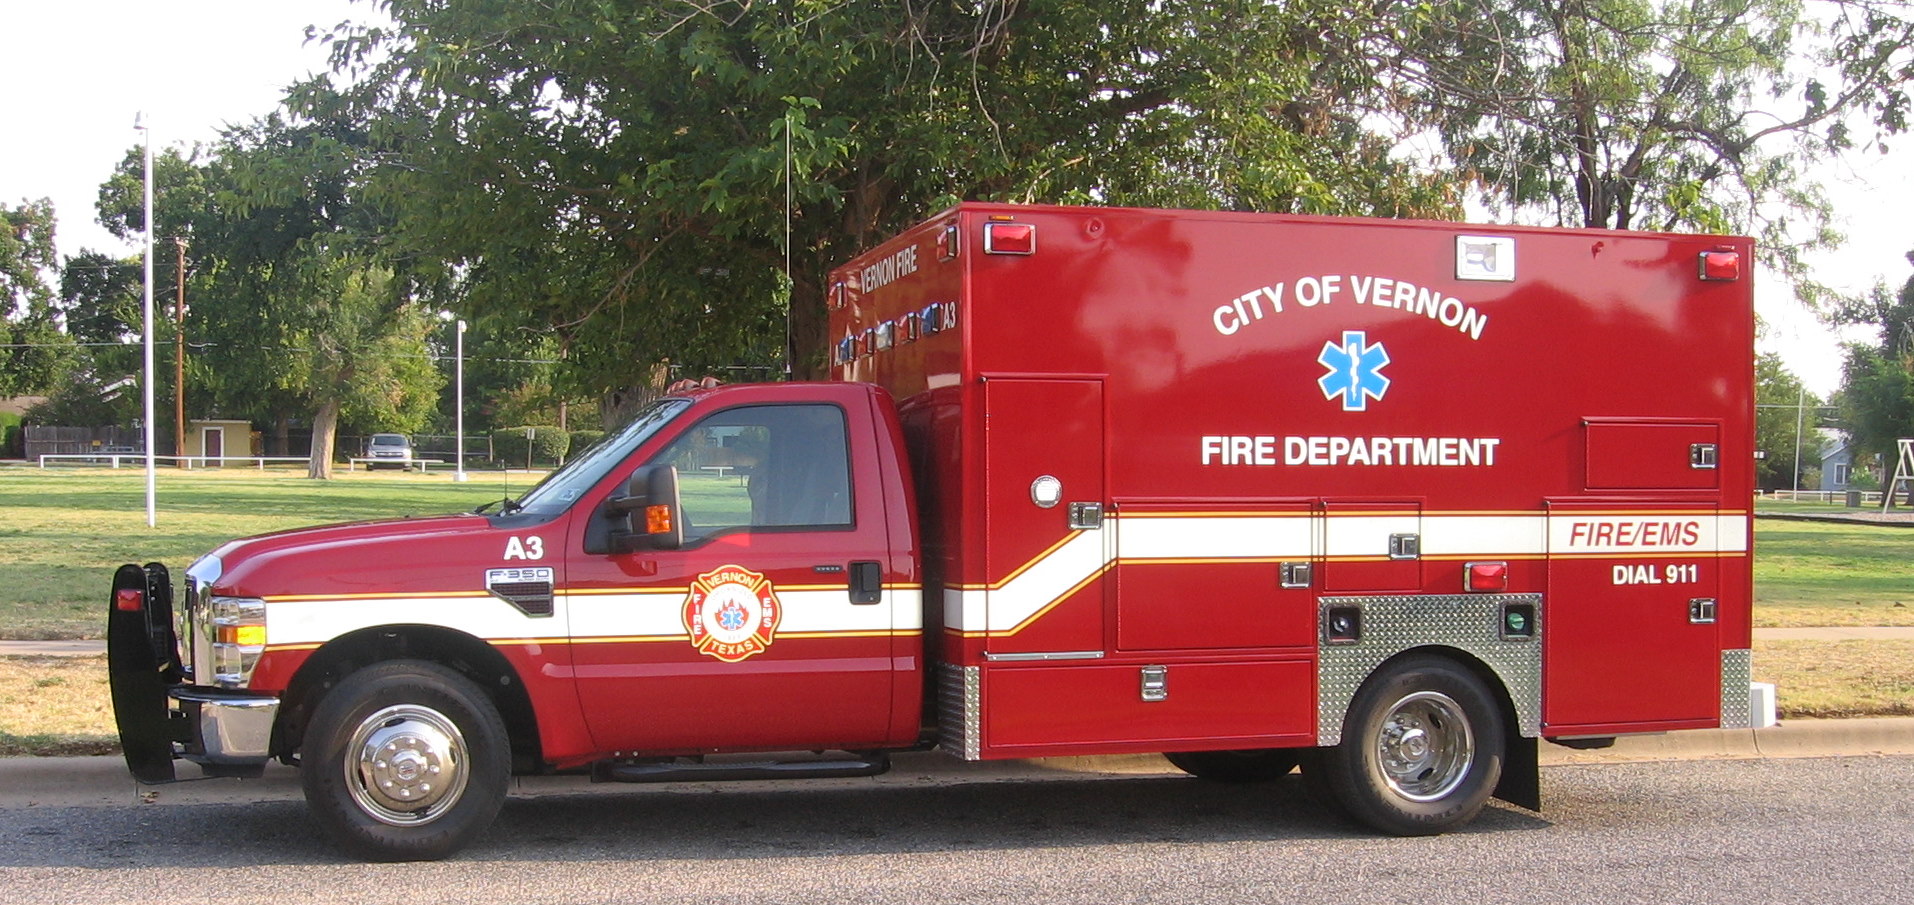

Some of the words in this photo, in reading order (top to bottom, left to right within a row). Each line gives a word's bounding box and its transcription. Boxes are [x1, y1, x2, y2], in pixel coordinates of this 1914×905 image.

[860, 255, 895, 294] VERNON
[896, 244, 917, 279] FIRE
[943, 301, 956, 330] A3
[1213, 282, 1284, 335] CITY
[1295, 275, 1341, 307] OF
[1350, 275, 1487, 340] VERNON
[1202, 436, 1276, 465] FIRE
[1284, 437, 1500, 466] DEPARTMENT
[503, 535, 543, 560] A3
[1569, 521, 1700, 547] FIRE/EMS
[707, 572, 755, 587] VERNON
[1612, 565, 1662, 585] DIAL
[1665, 564, 1698, 583] 911
[693, 593, 702, 635] FIRE
[762, 597, 773, 628] EMS
[711, 640, 754, 655] TEXAS
